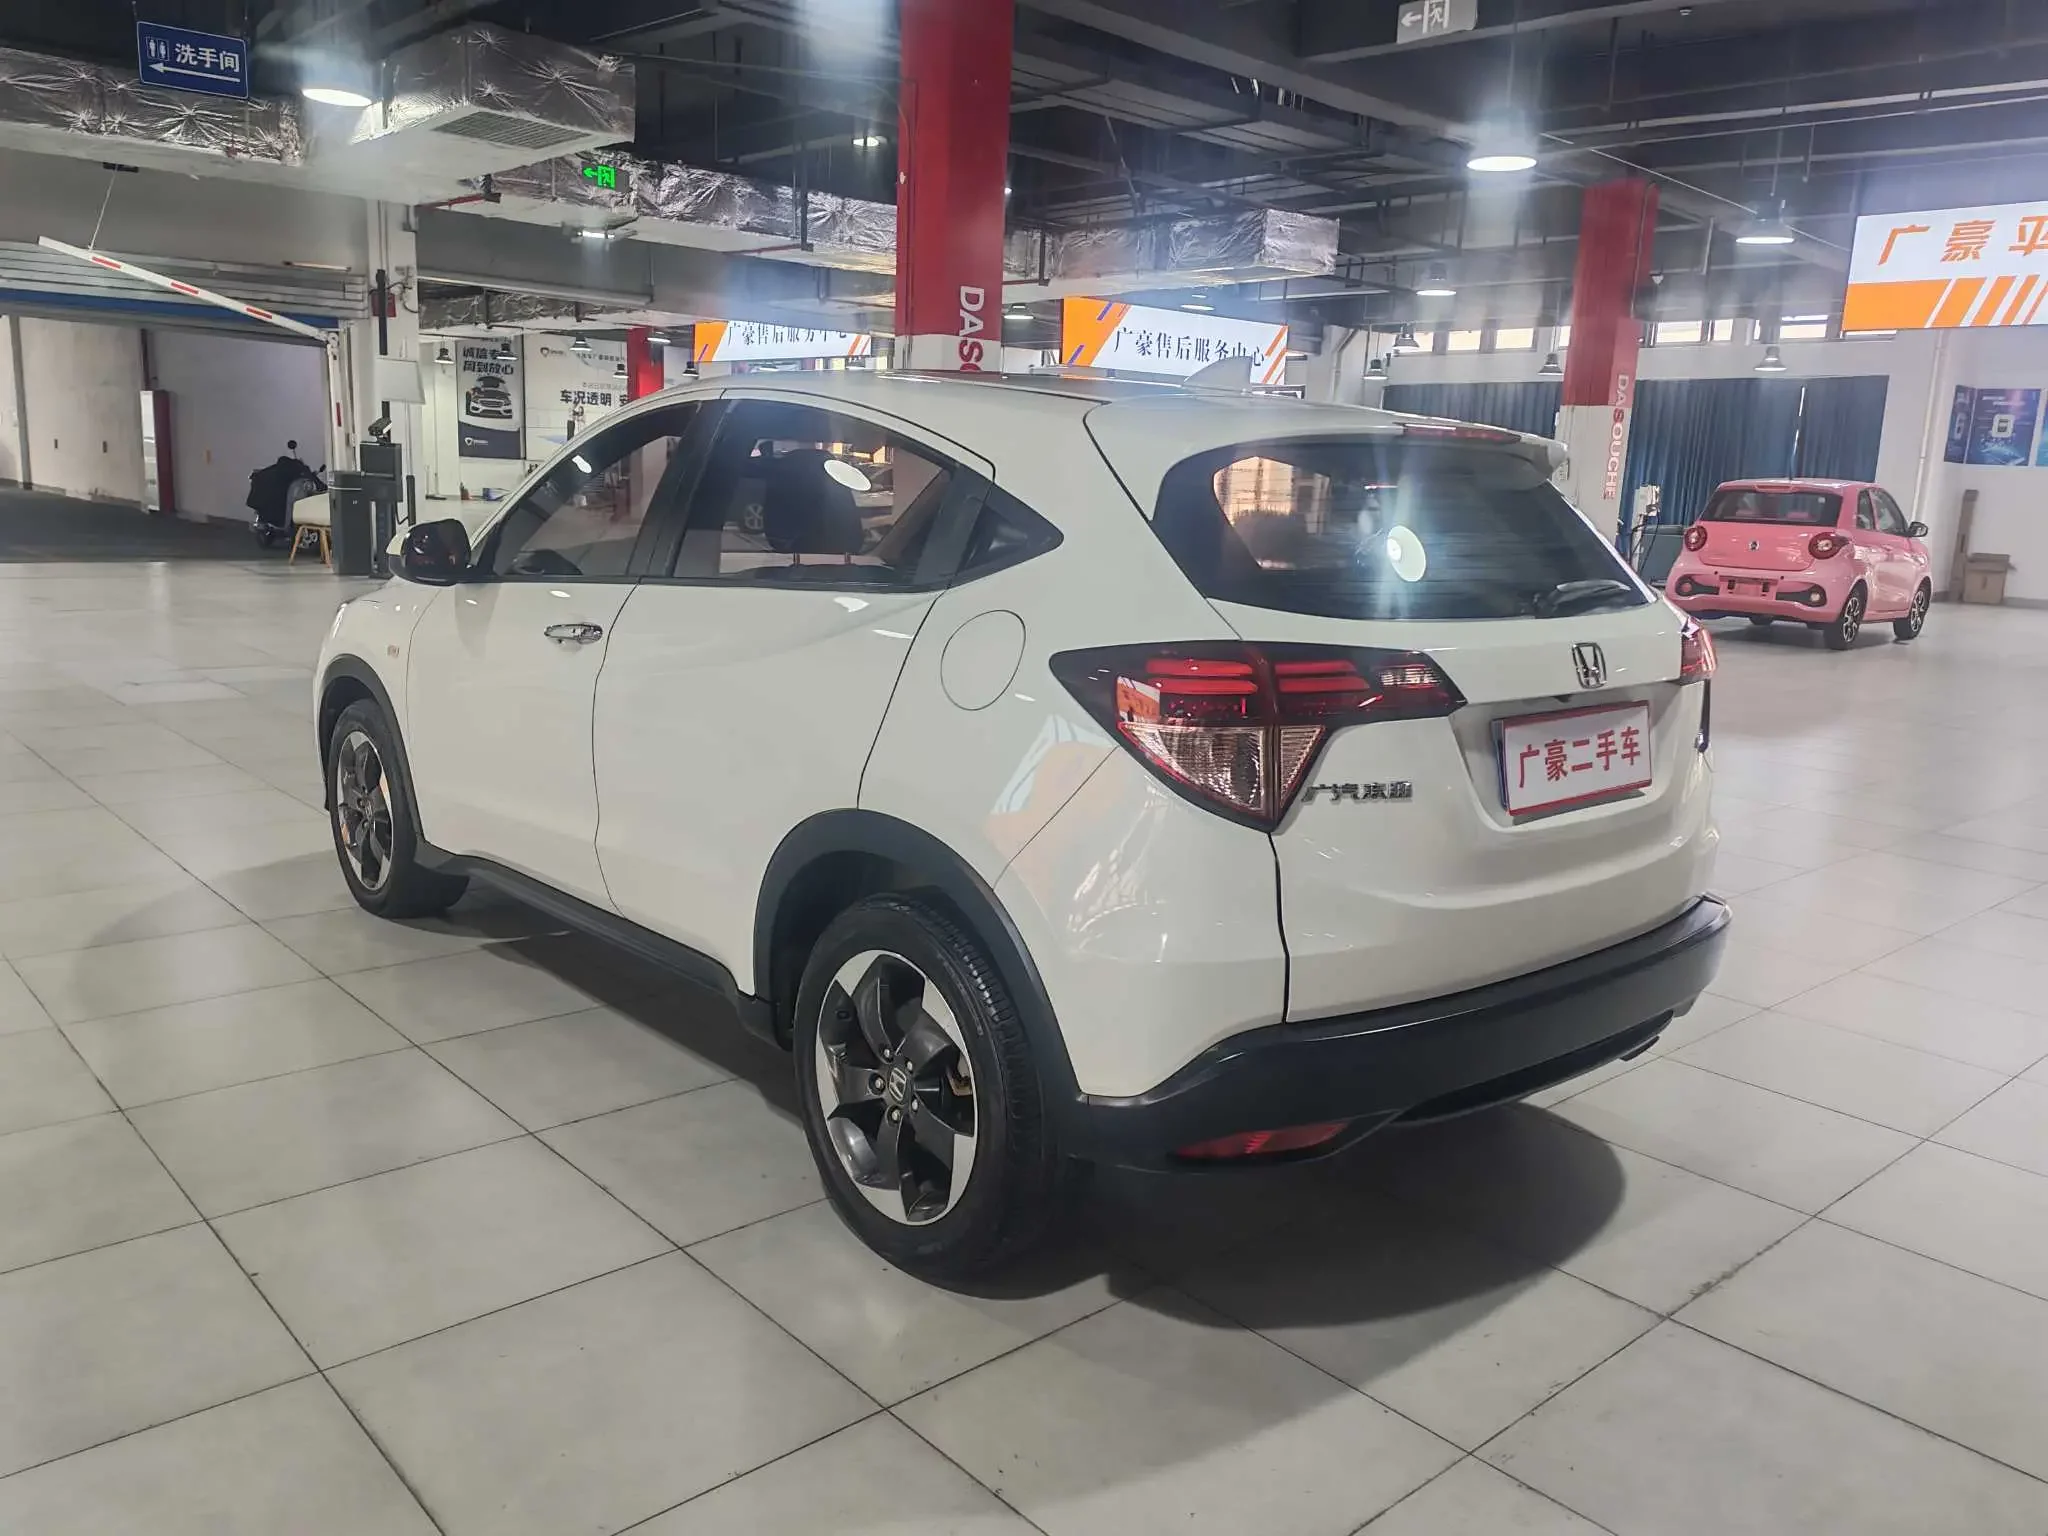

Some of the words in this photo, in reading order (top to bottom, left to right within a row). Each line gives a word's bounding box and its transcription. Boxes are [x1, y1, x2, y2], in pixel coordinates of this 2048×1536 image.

[174, 43, 240, 72] 洗手间
[560, 389, 612, 407] 车况透明
[1518, 726, 1642, 789] 广豪二手车
